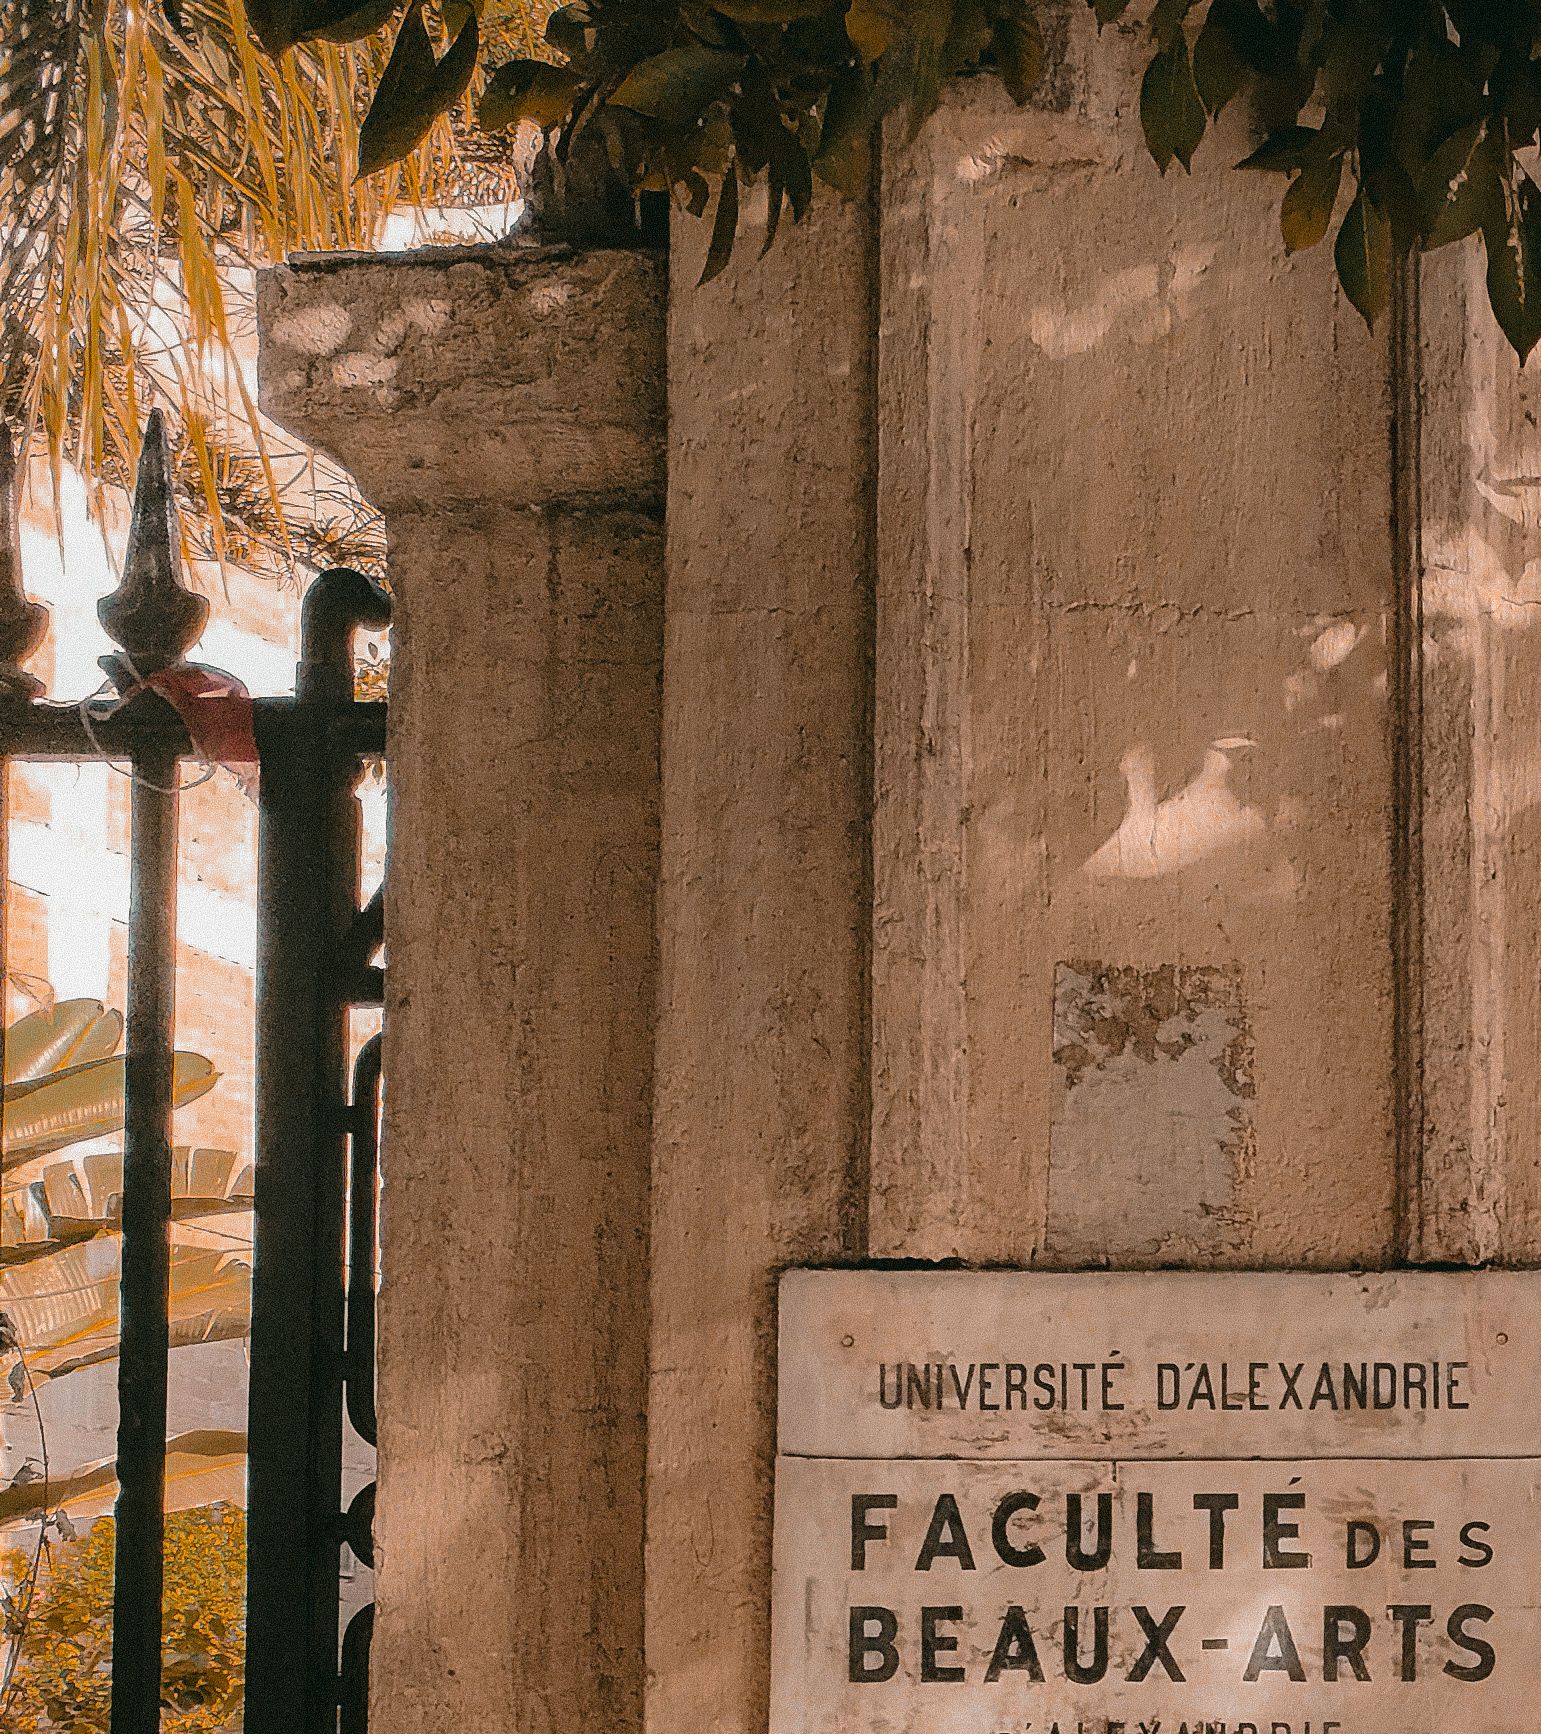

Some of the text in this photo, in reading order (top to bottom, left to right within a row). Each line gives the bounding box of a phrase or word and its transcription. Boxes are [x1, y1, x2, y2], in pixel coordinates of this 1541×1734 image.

[879, 1351, 1470, 1411] UNIVERSITÉ D'ALEXANDRIE
[851, 1478, 1494, 1572] FACULTÉ DES
[849, 1605, 1496, 1685] BEAUX-ARTS
